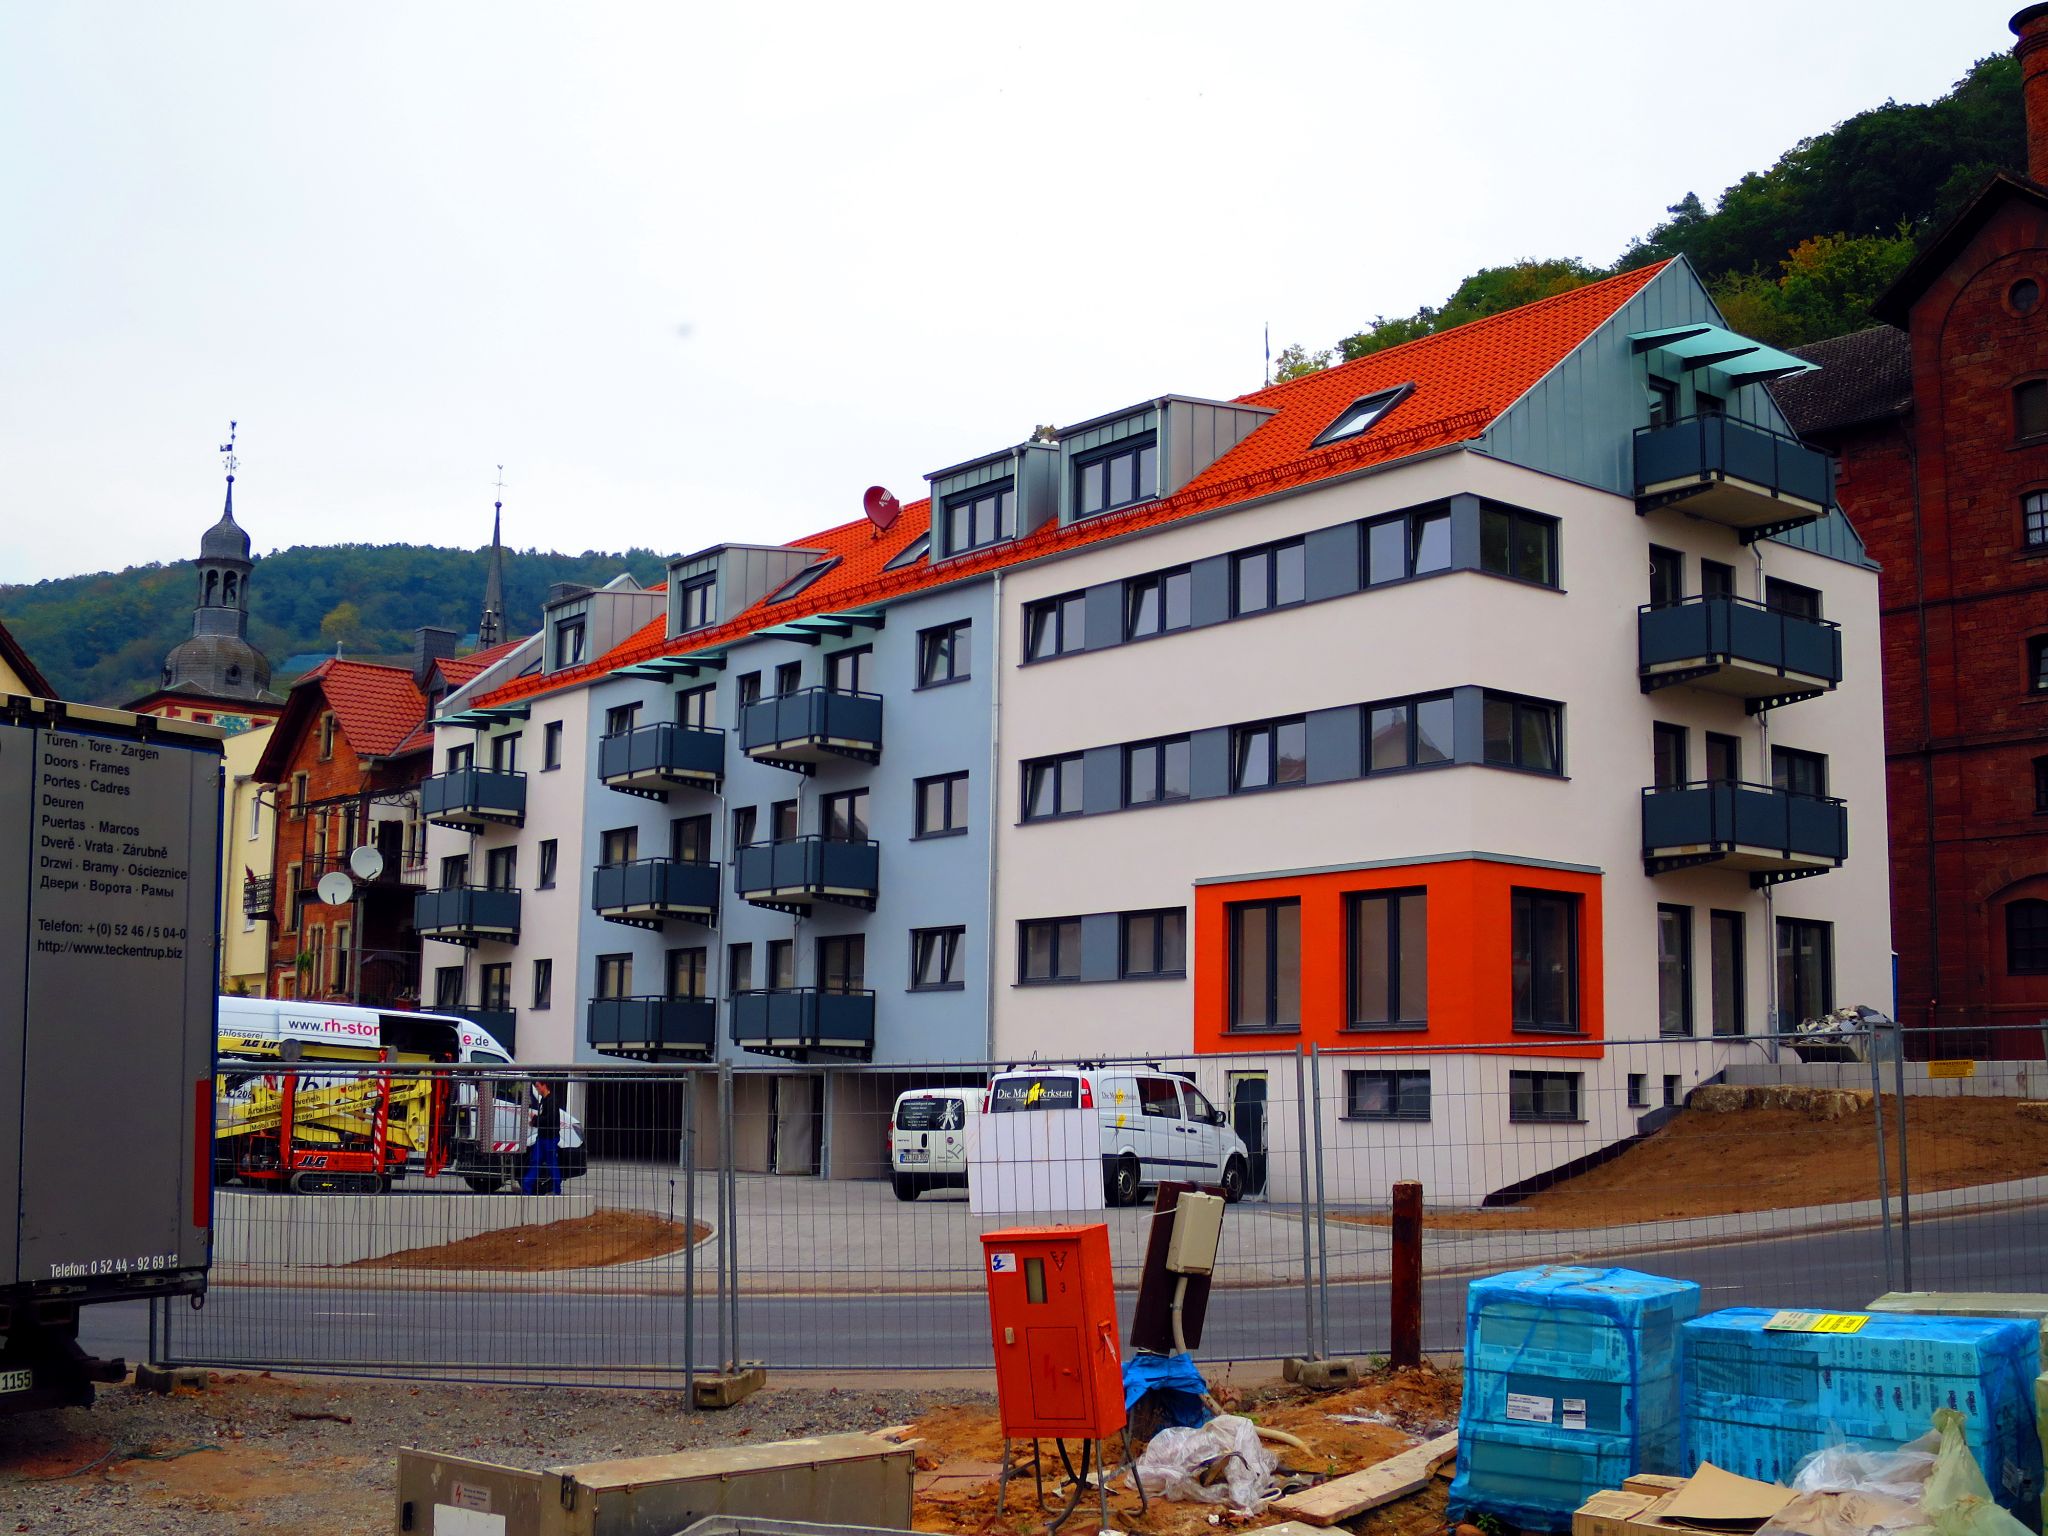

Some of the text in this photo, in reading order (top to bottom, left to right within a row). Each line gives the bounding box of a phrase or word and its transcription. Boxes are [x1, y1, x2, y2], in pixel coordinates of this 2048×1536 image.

[44, 732, 159, 761] Türen Tore Zargen
[44, 753, 130, 776] Doors Frames
[43, 773, 131, 796] Portes Cadres
[42, 794, 84, 810] Deuren
[42, 814, 140, 837] Puertas Marcos
[85, 839, 114, 854] Vrata
[122, 843, 168, 859] Zárubně
[40, 856, 73, 869] Drzwi
[82, 859, 119, 877] Bramy
[40, 875, 174, 898] Двери Ворота Рамы
[38, 918, 83, 934] Telefon:
[87, 922, 111, 937] +(0)
[114, 923, 128, 936] 52
[131, 924, 144, 937] 46
[153, 925, 159, 938] 5
[162, 926, 187, 940] 04-0
[37, 939, 184, 961] http://www.teckentrup.biz
[261, 1041, 280, 1049] LIF
[997, 1088, 1011, 1100] Die
[297, 1155, 328, 1168] JLG
[50, 1262, 88, 1279] Telefon:
[90, 1261, 97, 1275] 0
[100, 1260, 112, 1274] 52
[115, 1258, 128, 1272] 44
[137, 1256, 150, 1271] 92
[152, 1255, 164, 1269] 69
[2, 1371, 31, 1390] 1155
